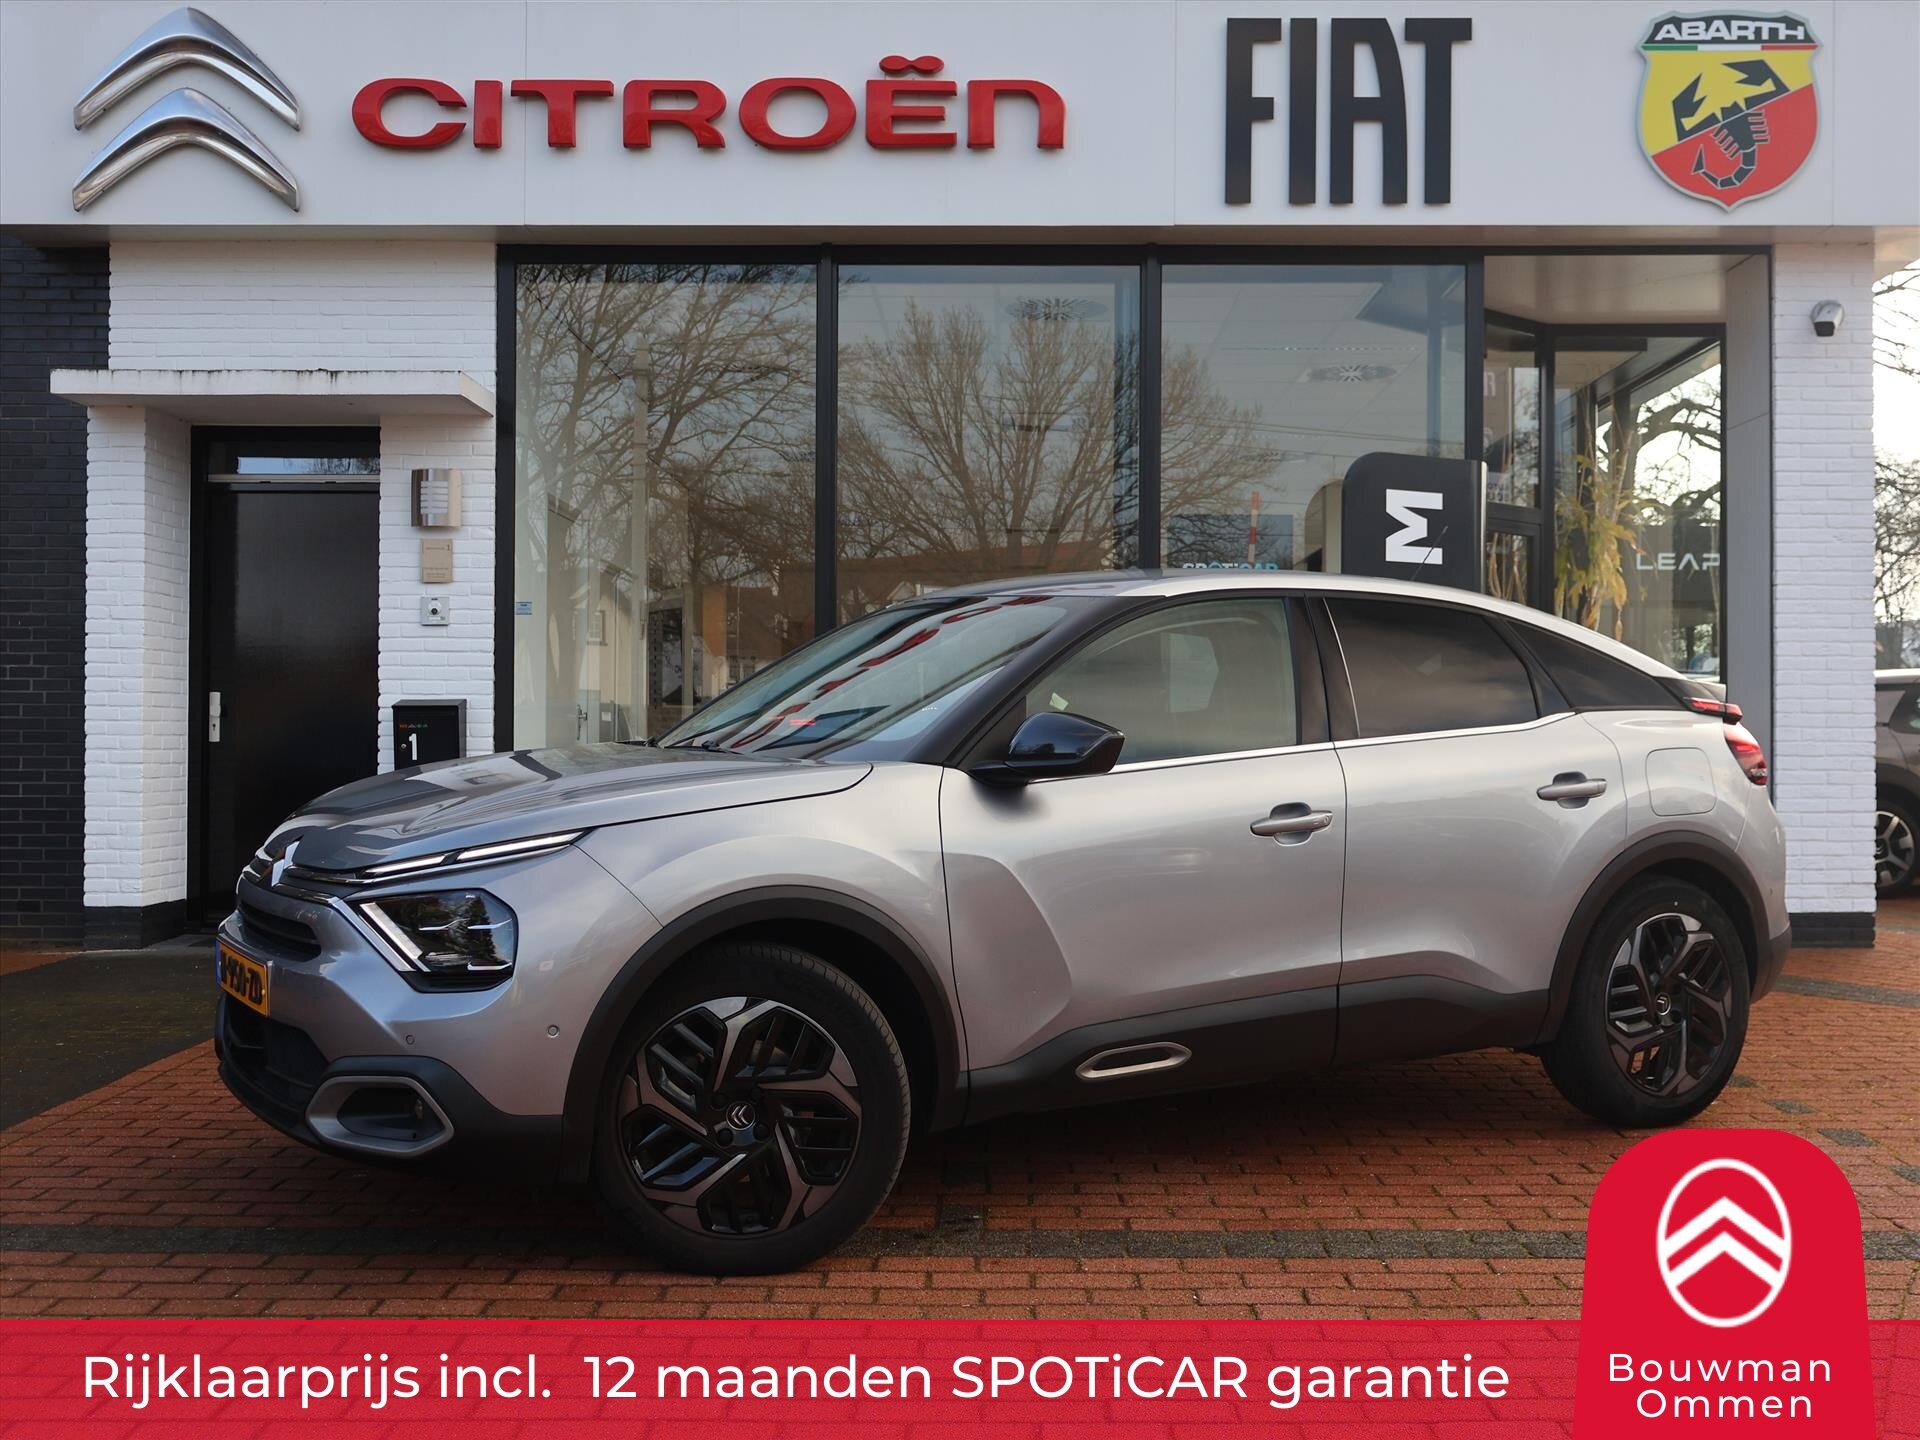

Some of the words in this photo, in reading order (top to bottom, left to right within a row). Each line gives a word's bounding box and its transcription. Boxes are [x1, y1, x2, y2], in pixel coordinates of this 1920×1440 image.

[1654, 19, 1805, 41] ABARTH
[1225, 17, 1472, 206] FIAT
[1636, 553, 1720, 570] LEAP
[409, 733, 418, 761] 1
